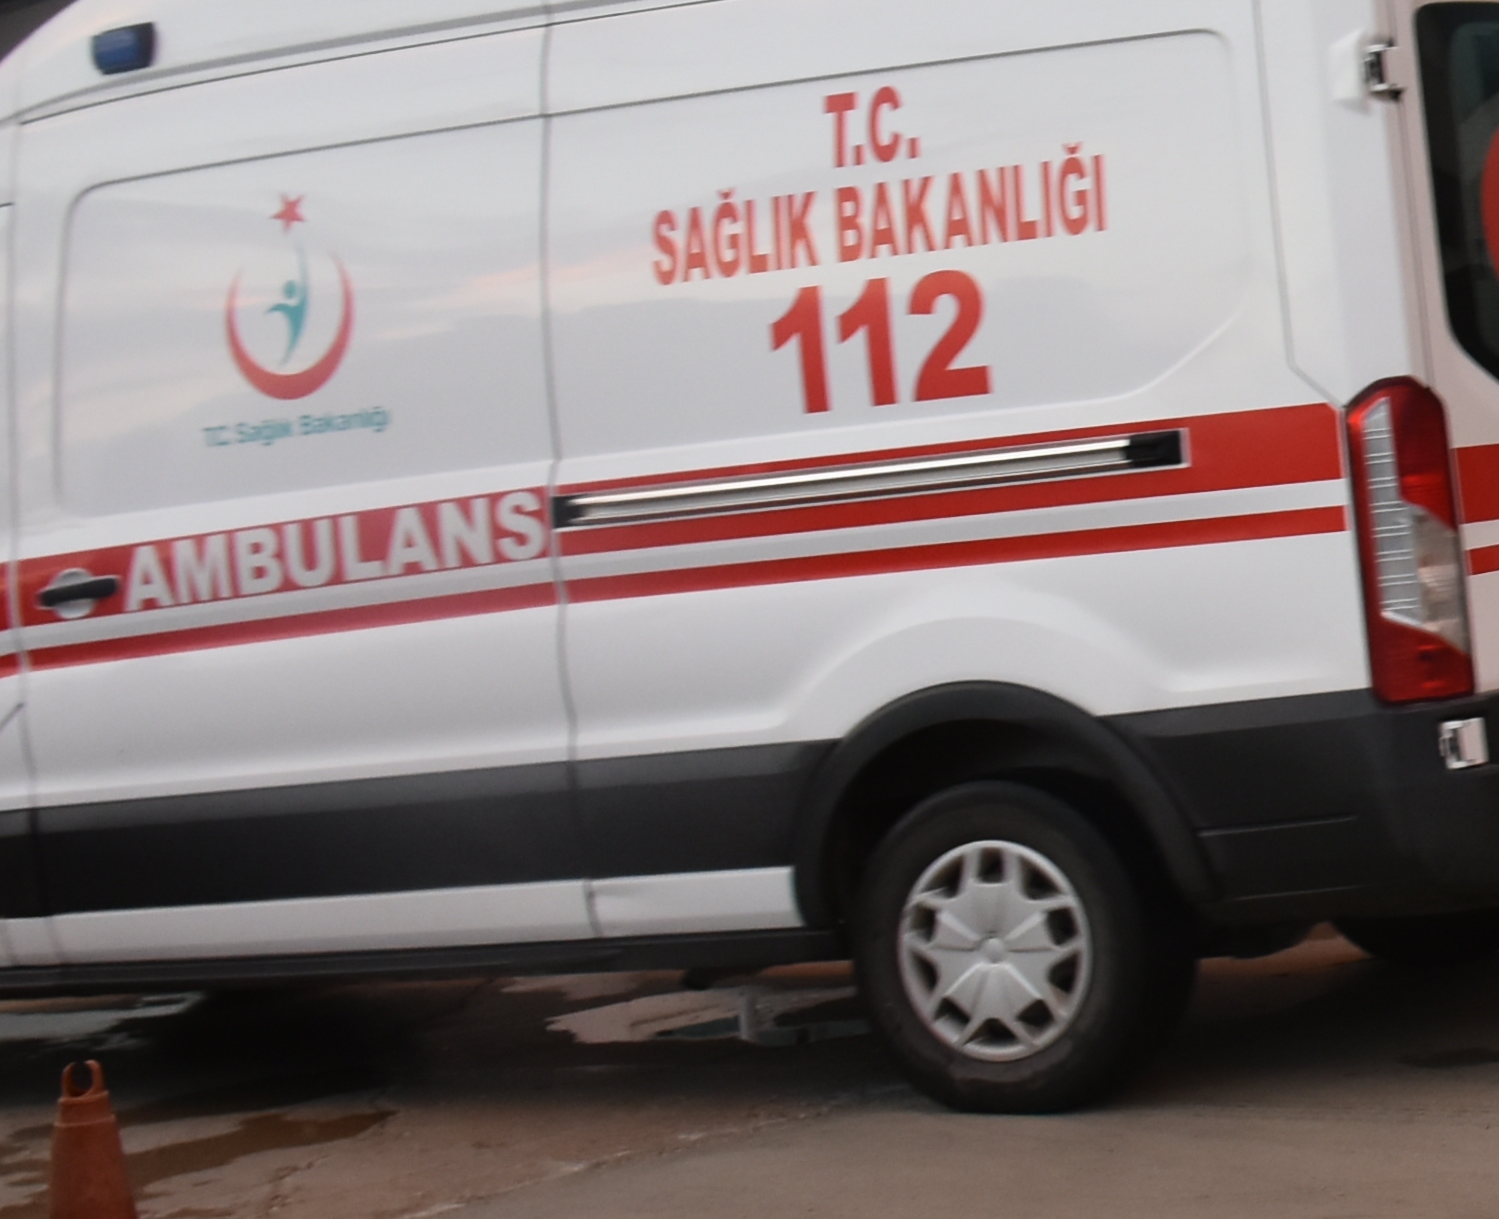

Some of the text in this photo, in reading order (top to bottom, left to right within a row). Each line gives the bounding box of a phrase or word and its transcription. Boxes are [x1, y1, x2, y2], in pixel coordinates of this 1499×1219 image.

[823, 85, 921, 168] T.C.
[652, 143, 1106, 286] SAĞLIK BAKANLIĞI
[769, 269, 993, 414] 112
[124, 491, 548, 612] AMBULANS
